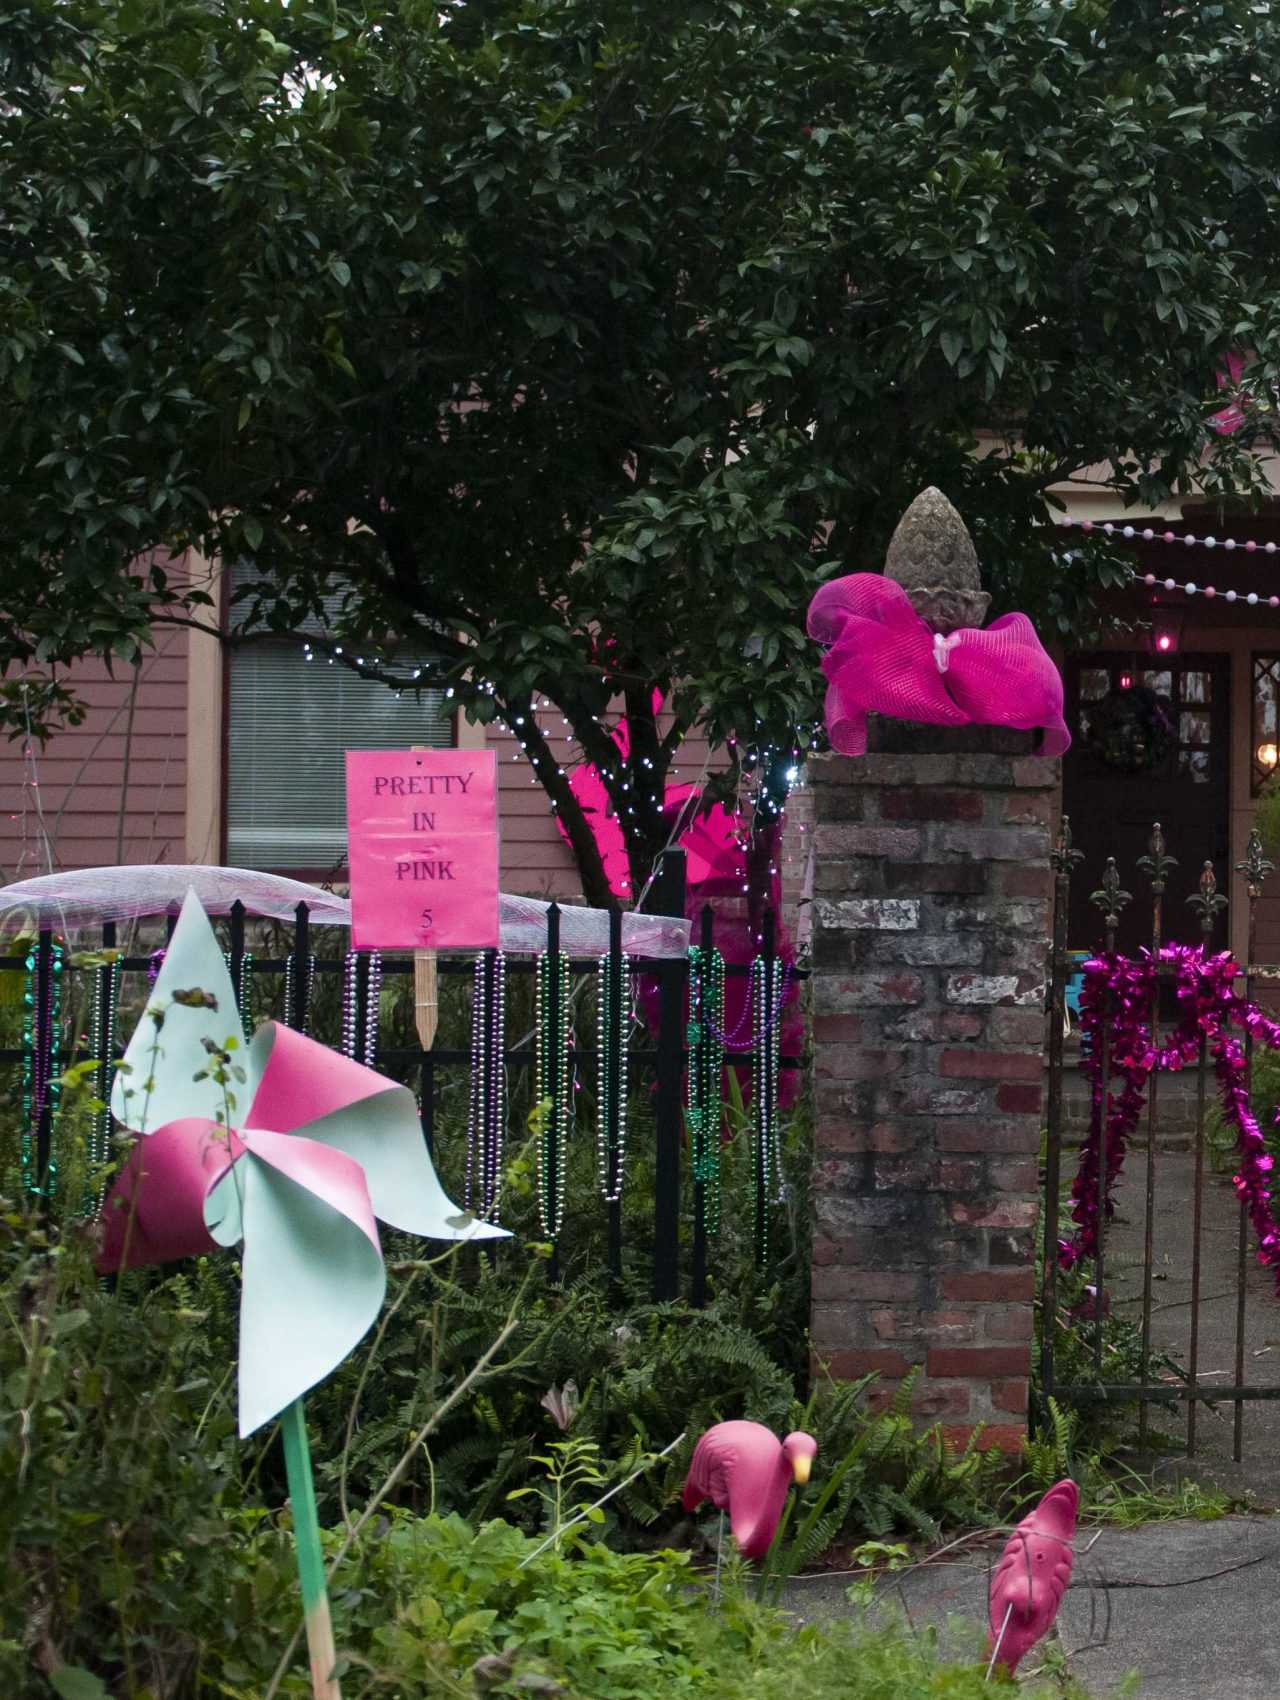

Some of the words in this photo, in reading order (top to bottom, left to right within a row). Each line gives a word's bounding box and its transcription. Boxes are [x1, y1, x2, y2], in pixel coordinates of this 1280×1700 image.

[374, 772, 473, 796] PRETTY
[412, 812, 435, 831] IN
[395, 861, 456, 881] PINK
[421, 908, 433, 929] 5
